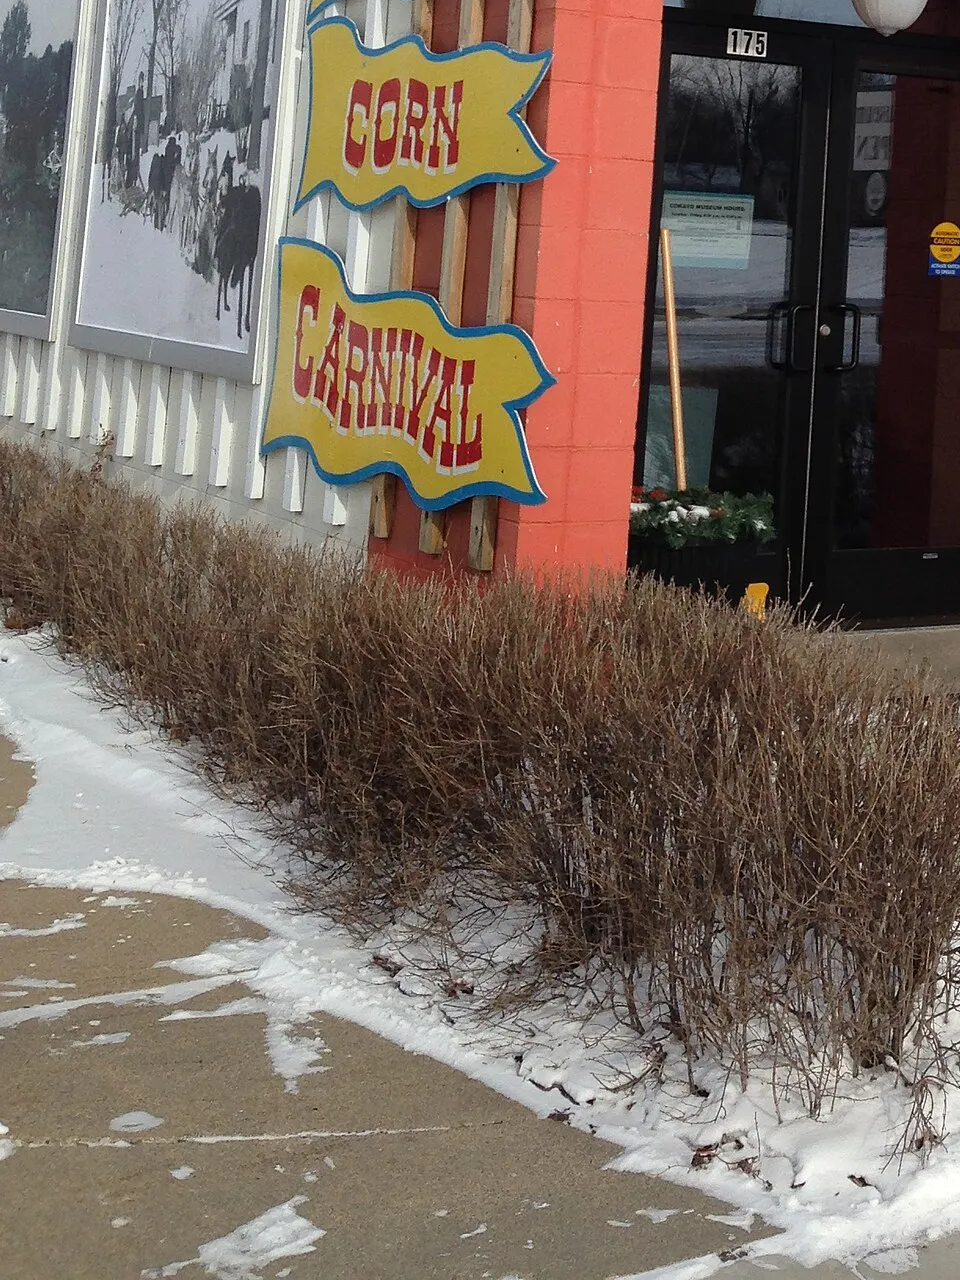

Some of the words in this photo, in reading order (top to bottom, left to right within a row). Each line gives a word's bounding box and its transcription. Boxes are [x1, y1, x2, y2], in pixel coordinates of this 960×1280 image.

[731, 30, 765, 56] 175
[341, 77, 464, 176] CORN
[290, 284, 483, 476] CARNIVAL
